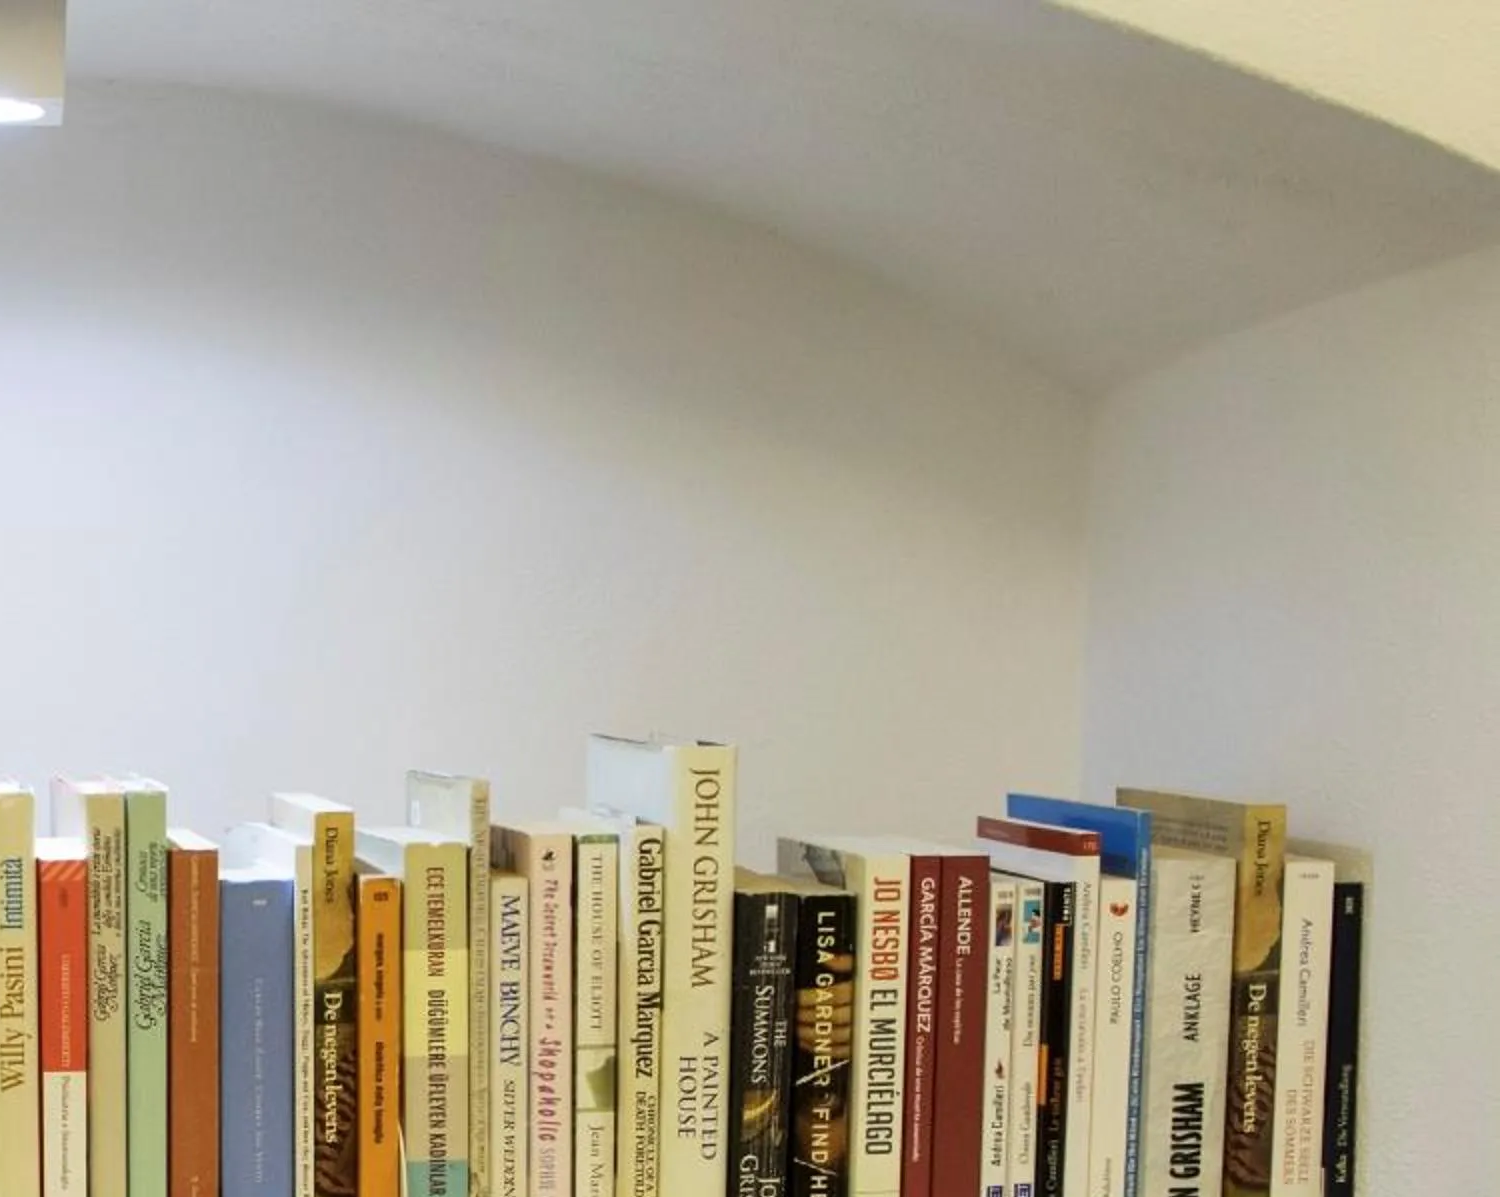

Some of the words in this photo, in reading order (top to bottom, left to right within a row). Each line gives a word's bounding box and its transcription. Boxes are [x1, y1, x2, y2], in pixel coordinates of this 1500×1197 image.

[690, 767, 721, 845] JOHN
[324, 826, 338, 863] Diana
[1256, 821, 1270, 858] Diana
[0, 857, 24, 931] Intimità
[324, 867, 338, 904] Jones
[426, 868, 444, 890] ECE
[637, 839, 662, 913] Gabriel
[873, 877, 901, 902] JO
[426, 893, 445, 977] TEMELKURAN
[500, 895, 520, 971] MAEVE
[691, 856, 717, 988] GRISHAM
[817, 911, 835, 963] LISA
[919, 877, 938, 942] GARCÍA
[955, 875, 973, 955] ALLENDE
[1300, 919, 1314, 962] Andrea
[637, 919, 661, 985] Garcia
[869, 910, 900, 980] NESBØ
[1111, 931, 1123, 983] COELHO
[0, 946, 25, 1020] Pasini
[323, 992, 341, 1022] De
[870, 989, 898, 1011] EL
[917, 946, 937, 1033] MÁRQUEZ
[1110, 985, 1121, 1024] PAULO
[1184, 974, 1202, 1043] ANKLAGE
[1249, 984, 1267, 1012] De
[1297, 966, 1312, 1027] Camilleri
[319, 1025, 339, 1082] negen
[428, 989, 449, 1068] DÜĞÜMLERE
[499, 981, 522, 1066] BINCHY
[630, 991, 660, 1078] Marquez
[703, 1032, 719, 1047] A
[750, 985, 770, 1084] SUMMONS
[774, 1021, 787, 1046] THE
[813, 973, 834, 1086] GARDNER
[1243, 1016, 1262, 1072] negen
[1, 1029, 32, 1092] Willy
[865, 1018, 899, 1155] MURCIÉLAGO
[323, 1085, 343, 1143] levens
[428, 1074, 451, 1129] ÜFLEYEN
[502, 1080, 518, 1129] SILVER
[677, 1056, 697, 1138] HOUSE
[700, 1055, 719, 1160] PAINTED
[1243, 1075, 1263, 1134] levens
[810, 1107, 830, 1164] FIND
[1169, 1083, 1204, 1180] GRISHAM
[429, 1133, 448, 1196] KADINLAR
